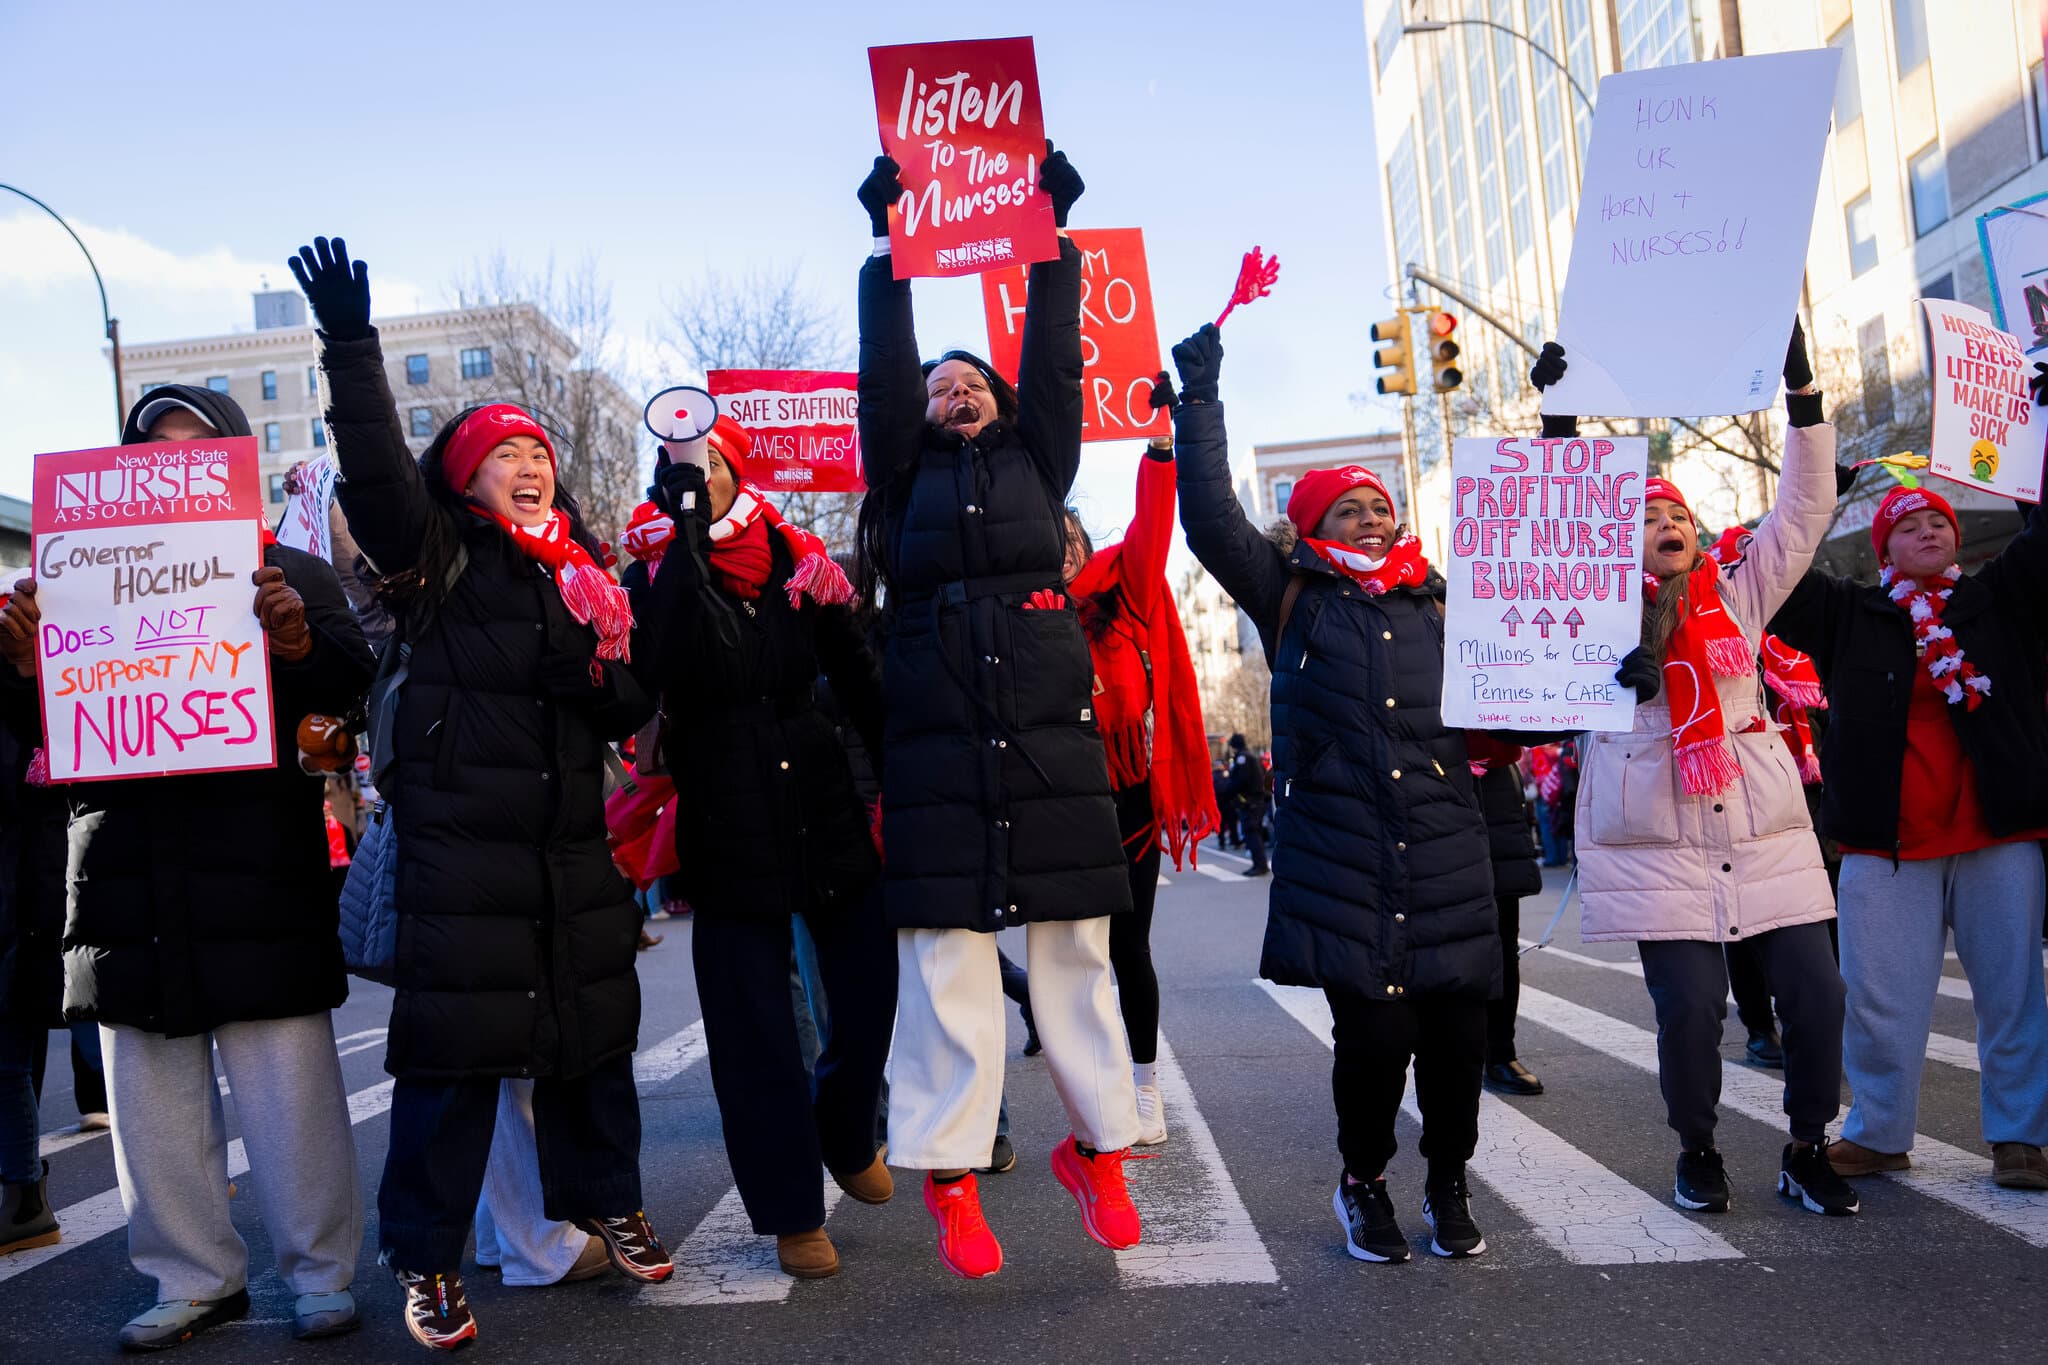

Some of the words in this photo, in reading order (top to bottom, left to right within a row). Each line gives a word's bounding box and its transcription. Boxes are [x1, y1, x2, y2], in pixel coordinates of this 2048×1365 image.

[896, 67, 1023, 141] listen
[1636, 95, 1718, 132] HONK
[1637, 147, 1676, 170] UR
[897, 153, 1035, 237] Nurses!
[1601, 192, 1655, 222] HORN
[936, 241, 1013, 263] NURSES
[937, 252, 1014, 269] ASSOCIATION
[999, 278, 1136, 334] HRO
[1947, 355, 2037, 401] LITERALLY
[730, 399, 771, 422] SAFE
[777, 396, 858, 421] STAFFING
[1953, 381, 2004, 418] MAKE
[2007, 397, 2031, 426] US
[799, 436, 845, 461] LIVES
[1969, 412, 2010, 447] SICK
[116, 454, 151, 469] New
[153, 449, 187, 466] York
[191, 449, 228, 464] State
[1490, 437, 1615, 474] STOP
[55, 461, 230, 509] NURSES
[1456, 472, 1641, 521] PROFITING
[54, 497, 232, 523] ASSOCIATION
[40, 535, 164, 579] Governor
[1453, 517, 1520, 558] OFF
[1531, 519, 1636, 558] NURSE
[114, 556, 235, 605] HOCHUL
[1471, 561, 1636, 602] BURNOUT
[43, 624, 114, 658] DOES
[136, 606, 217, 641] NOT
[55, 655, 181, 696] SUPPORT
[189, 639, 253, 681] NY
[1459, 640, 1535, 669] Millions
[1543, 643, 1560, 660] for
[1472, 673, 1534, 702] Pennies
[1542, 687, 1557, 701] for
[1565, 681, 1618, 701] CARE
[73, 688, 258, 771] NURSES
[1478, 713, 1512, 722] SHAME
[1520, 715, 1542, 724] ON
[1551, 714, 1585, 726] NYP!
